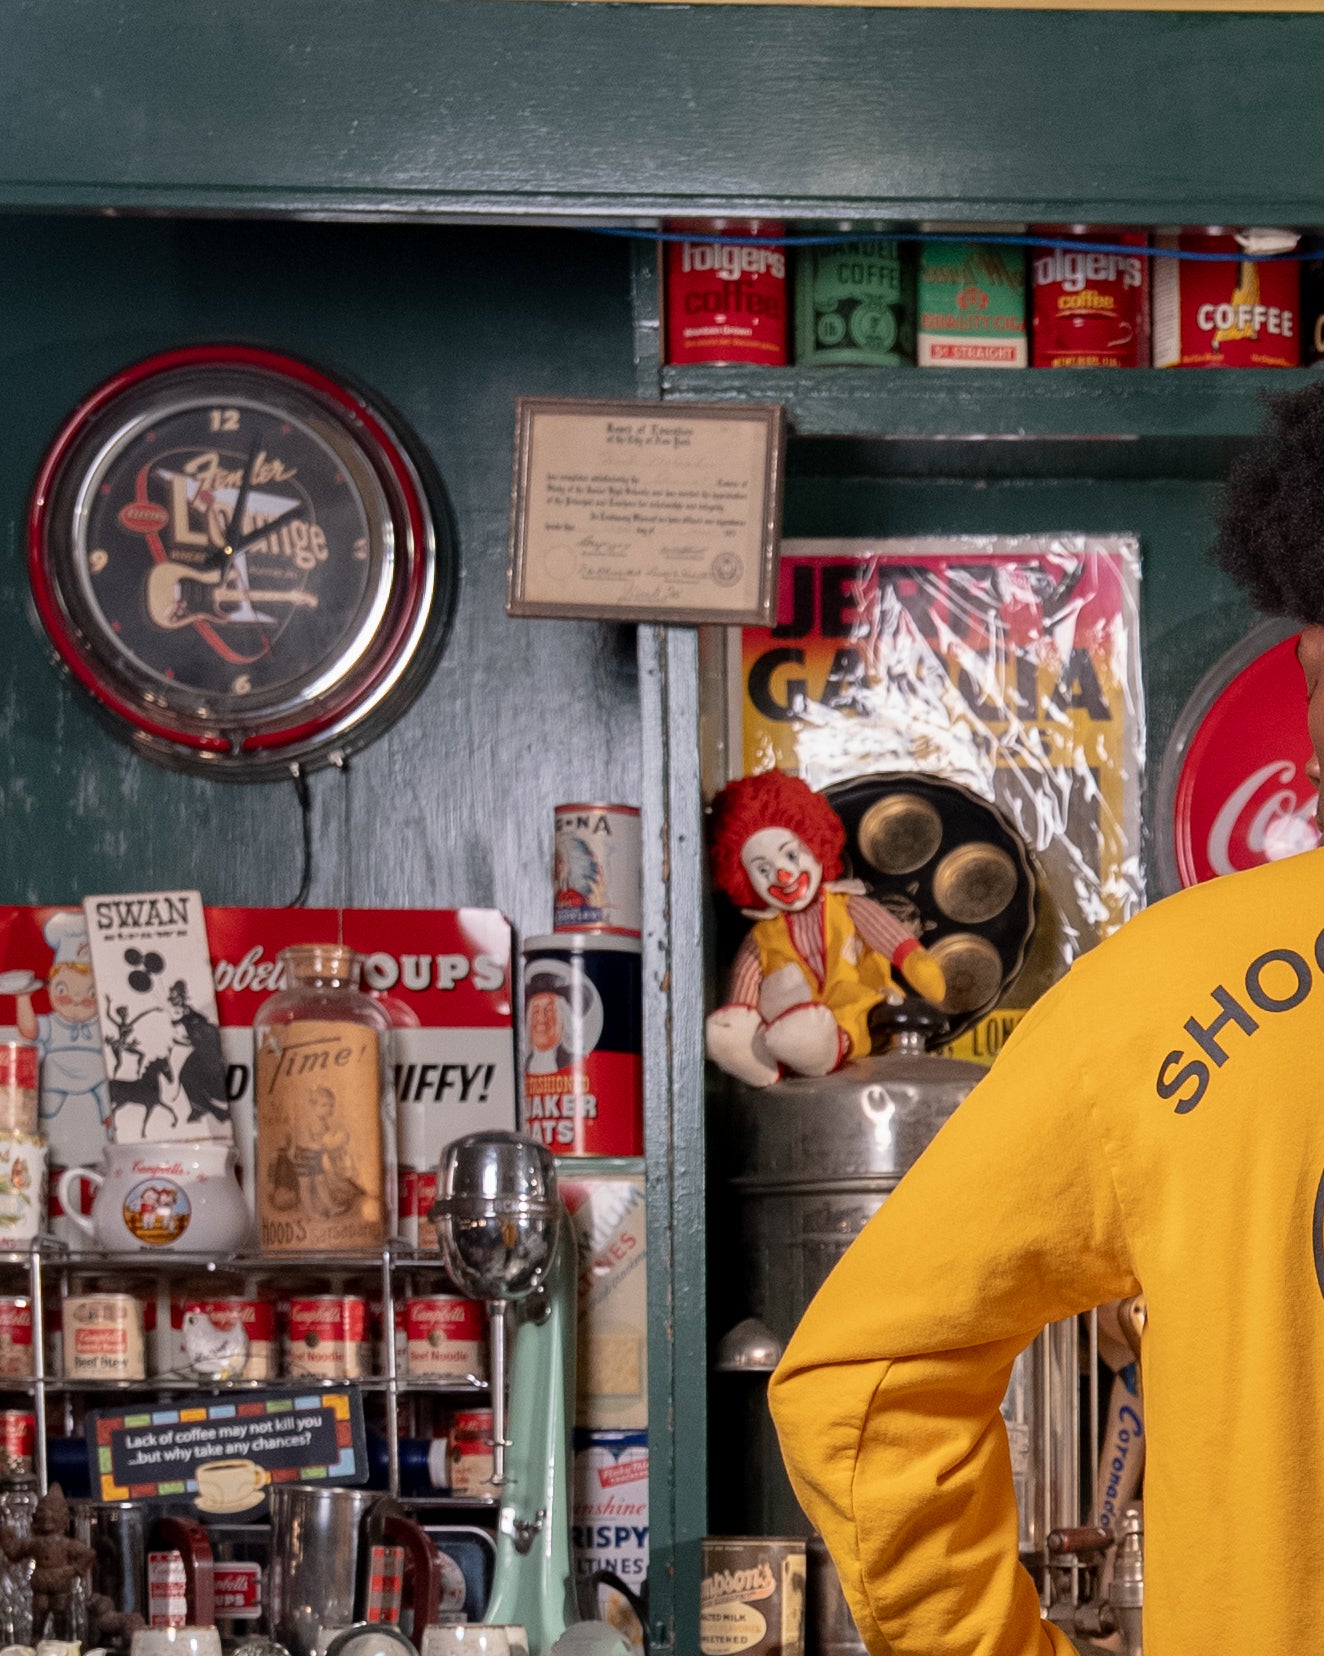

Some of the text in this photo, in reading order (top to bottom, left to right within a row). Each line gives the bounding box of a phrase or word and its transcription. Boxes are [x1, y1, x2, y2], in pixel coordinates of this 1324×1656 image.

[1057, 290, 1114, 309] coffee
[1197, 303, 1293, 338] COFFEE
[209, 409, 241, 432] 12
[89, 549, 109, 574] 9
[232, 674, 251, 695] 6
[96, 897, 190, 930] SWAN
[362, 951, 506, 991] OUPS
[126, 1416, 322, 1449] Lack of coffee may not kill you
[164, 1447, 192, 1463] why
[194, 1442, 223, 1459] take
[225, 1440, 249, 1456] any
[252, 1432, 312, 1452] chances?
[573, 1496, 647, 1518] nshine
